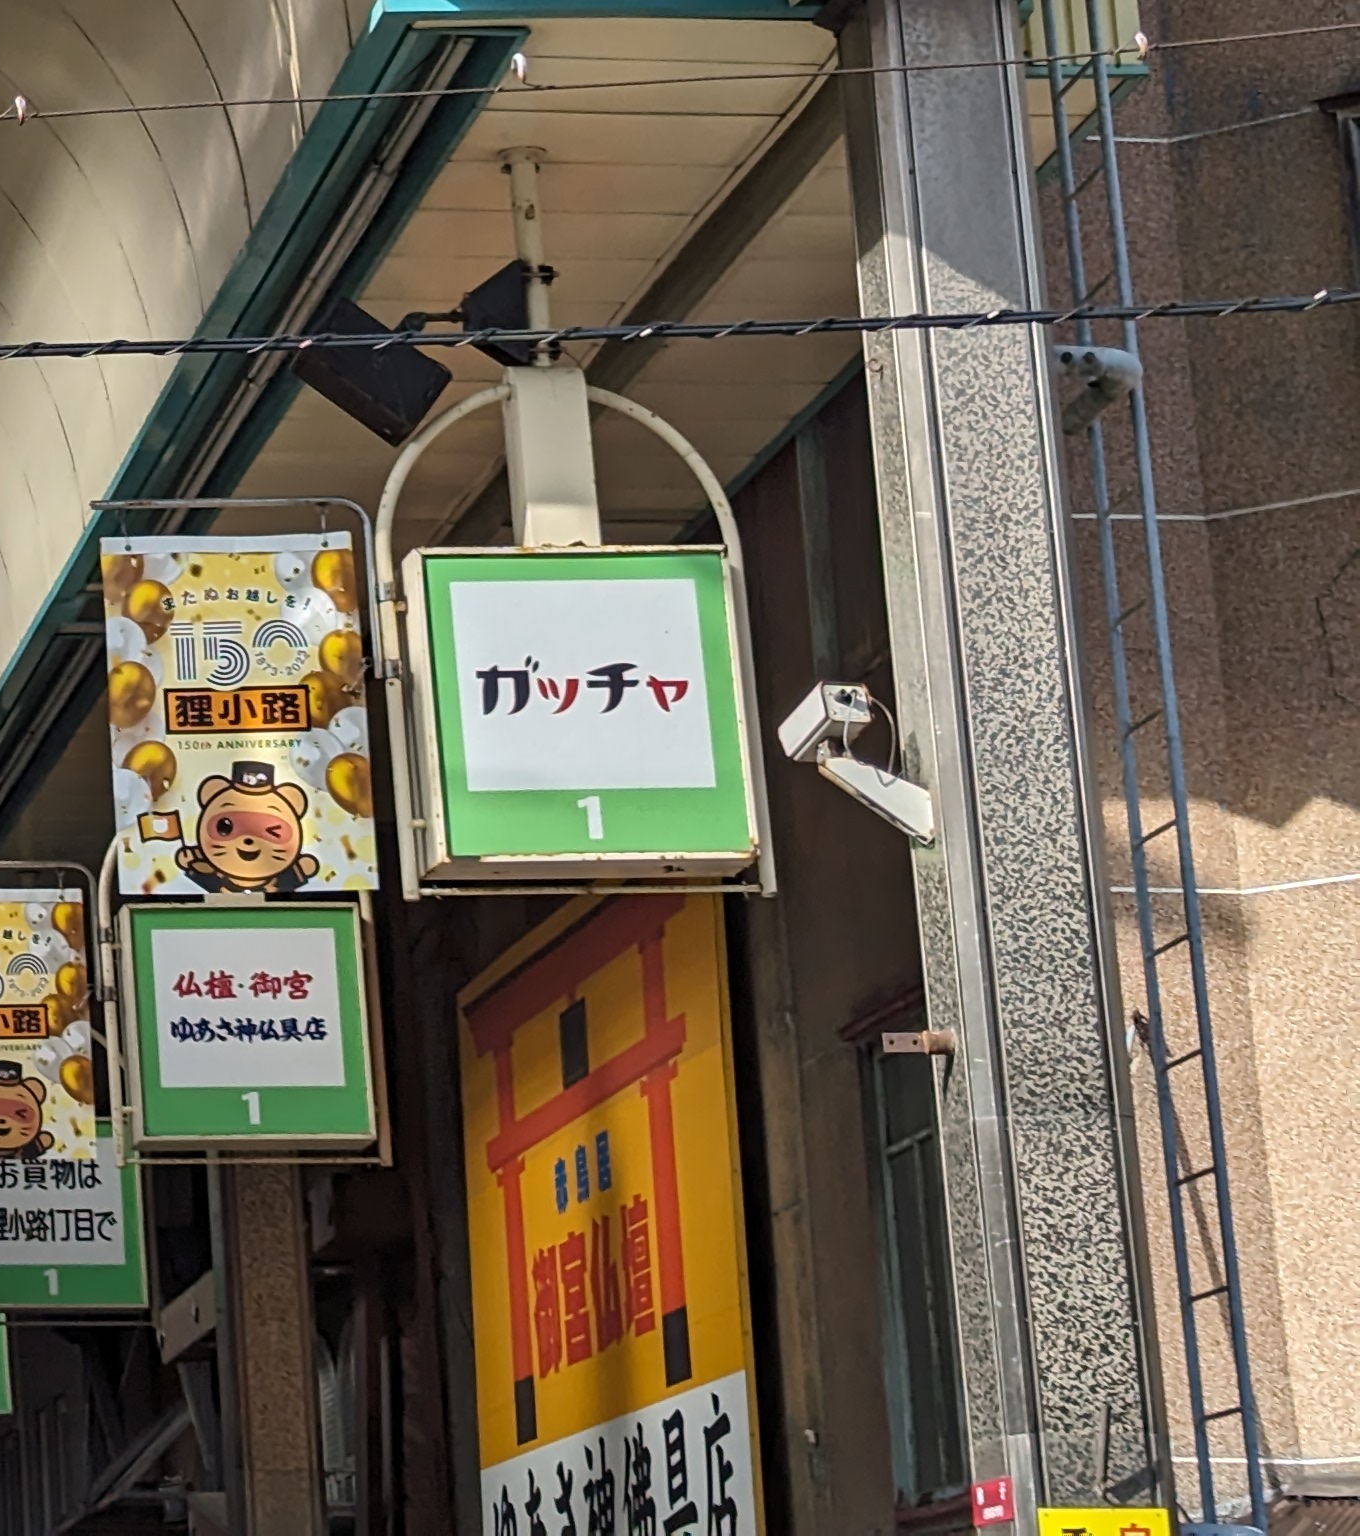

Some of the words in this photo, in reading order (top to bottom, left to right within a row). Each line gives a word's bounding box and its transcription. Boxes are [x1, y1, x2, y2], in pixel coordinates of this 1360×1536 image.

[170, 620, 309, 686] 150
[475, 655, 689, 715] ガッチャ
[174, 692, 301, 727] 狸小路
[178, 740, 212, 750] 150th
[217, 739, 302, 750] ANNIVERSARY
[577, 796, 603, 840] 1
[241, 1091, 261, 1125] 1
[43, 1268, 59, 1296] 1
